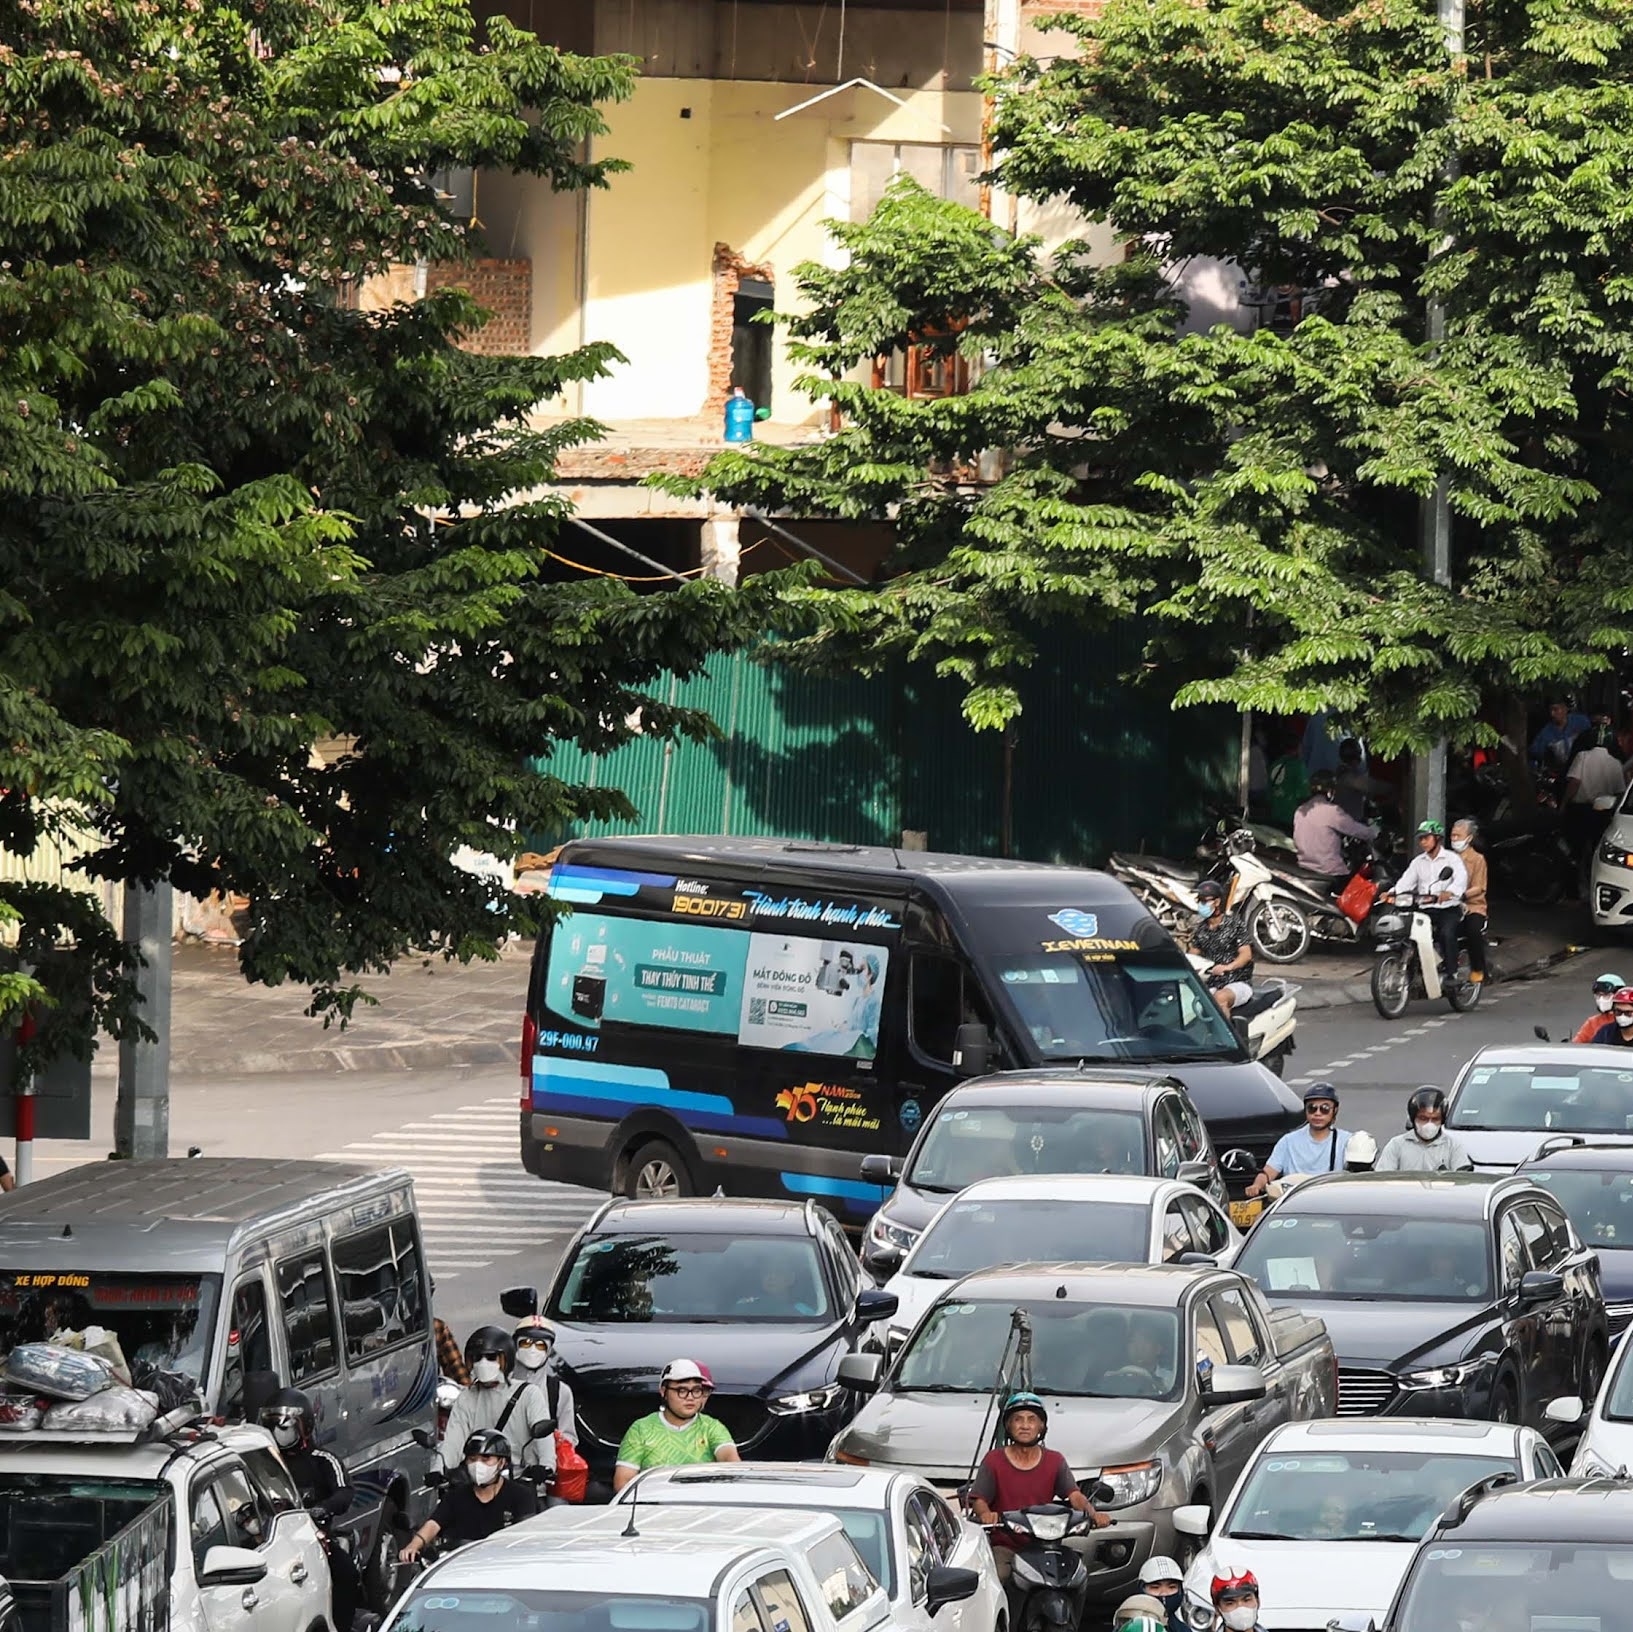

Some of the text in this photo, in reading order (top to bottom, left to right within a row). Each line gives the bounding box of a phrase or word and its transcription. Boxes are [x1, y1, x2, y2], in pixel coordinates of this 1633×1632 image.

[675, 880, 709, 895] Hotline:
[672, 896, 747, 920] 19001731
[742, 890, 789, 916] Hành
[786, 896, 822, 921] trình
[854, 906, 900, 931] phúc
[539, 1029, 599, 1053] 29F-000.97
[14, 1273, 90, 1288] XE HỢP ĐỒNG
